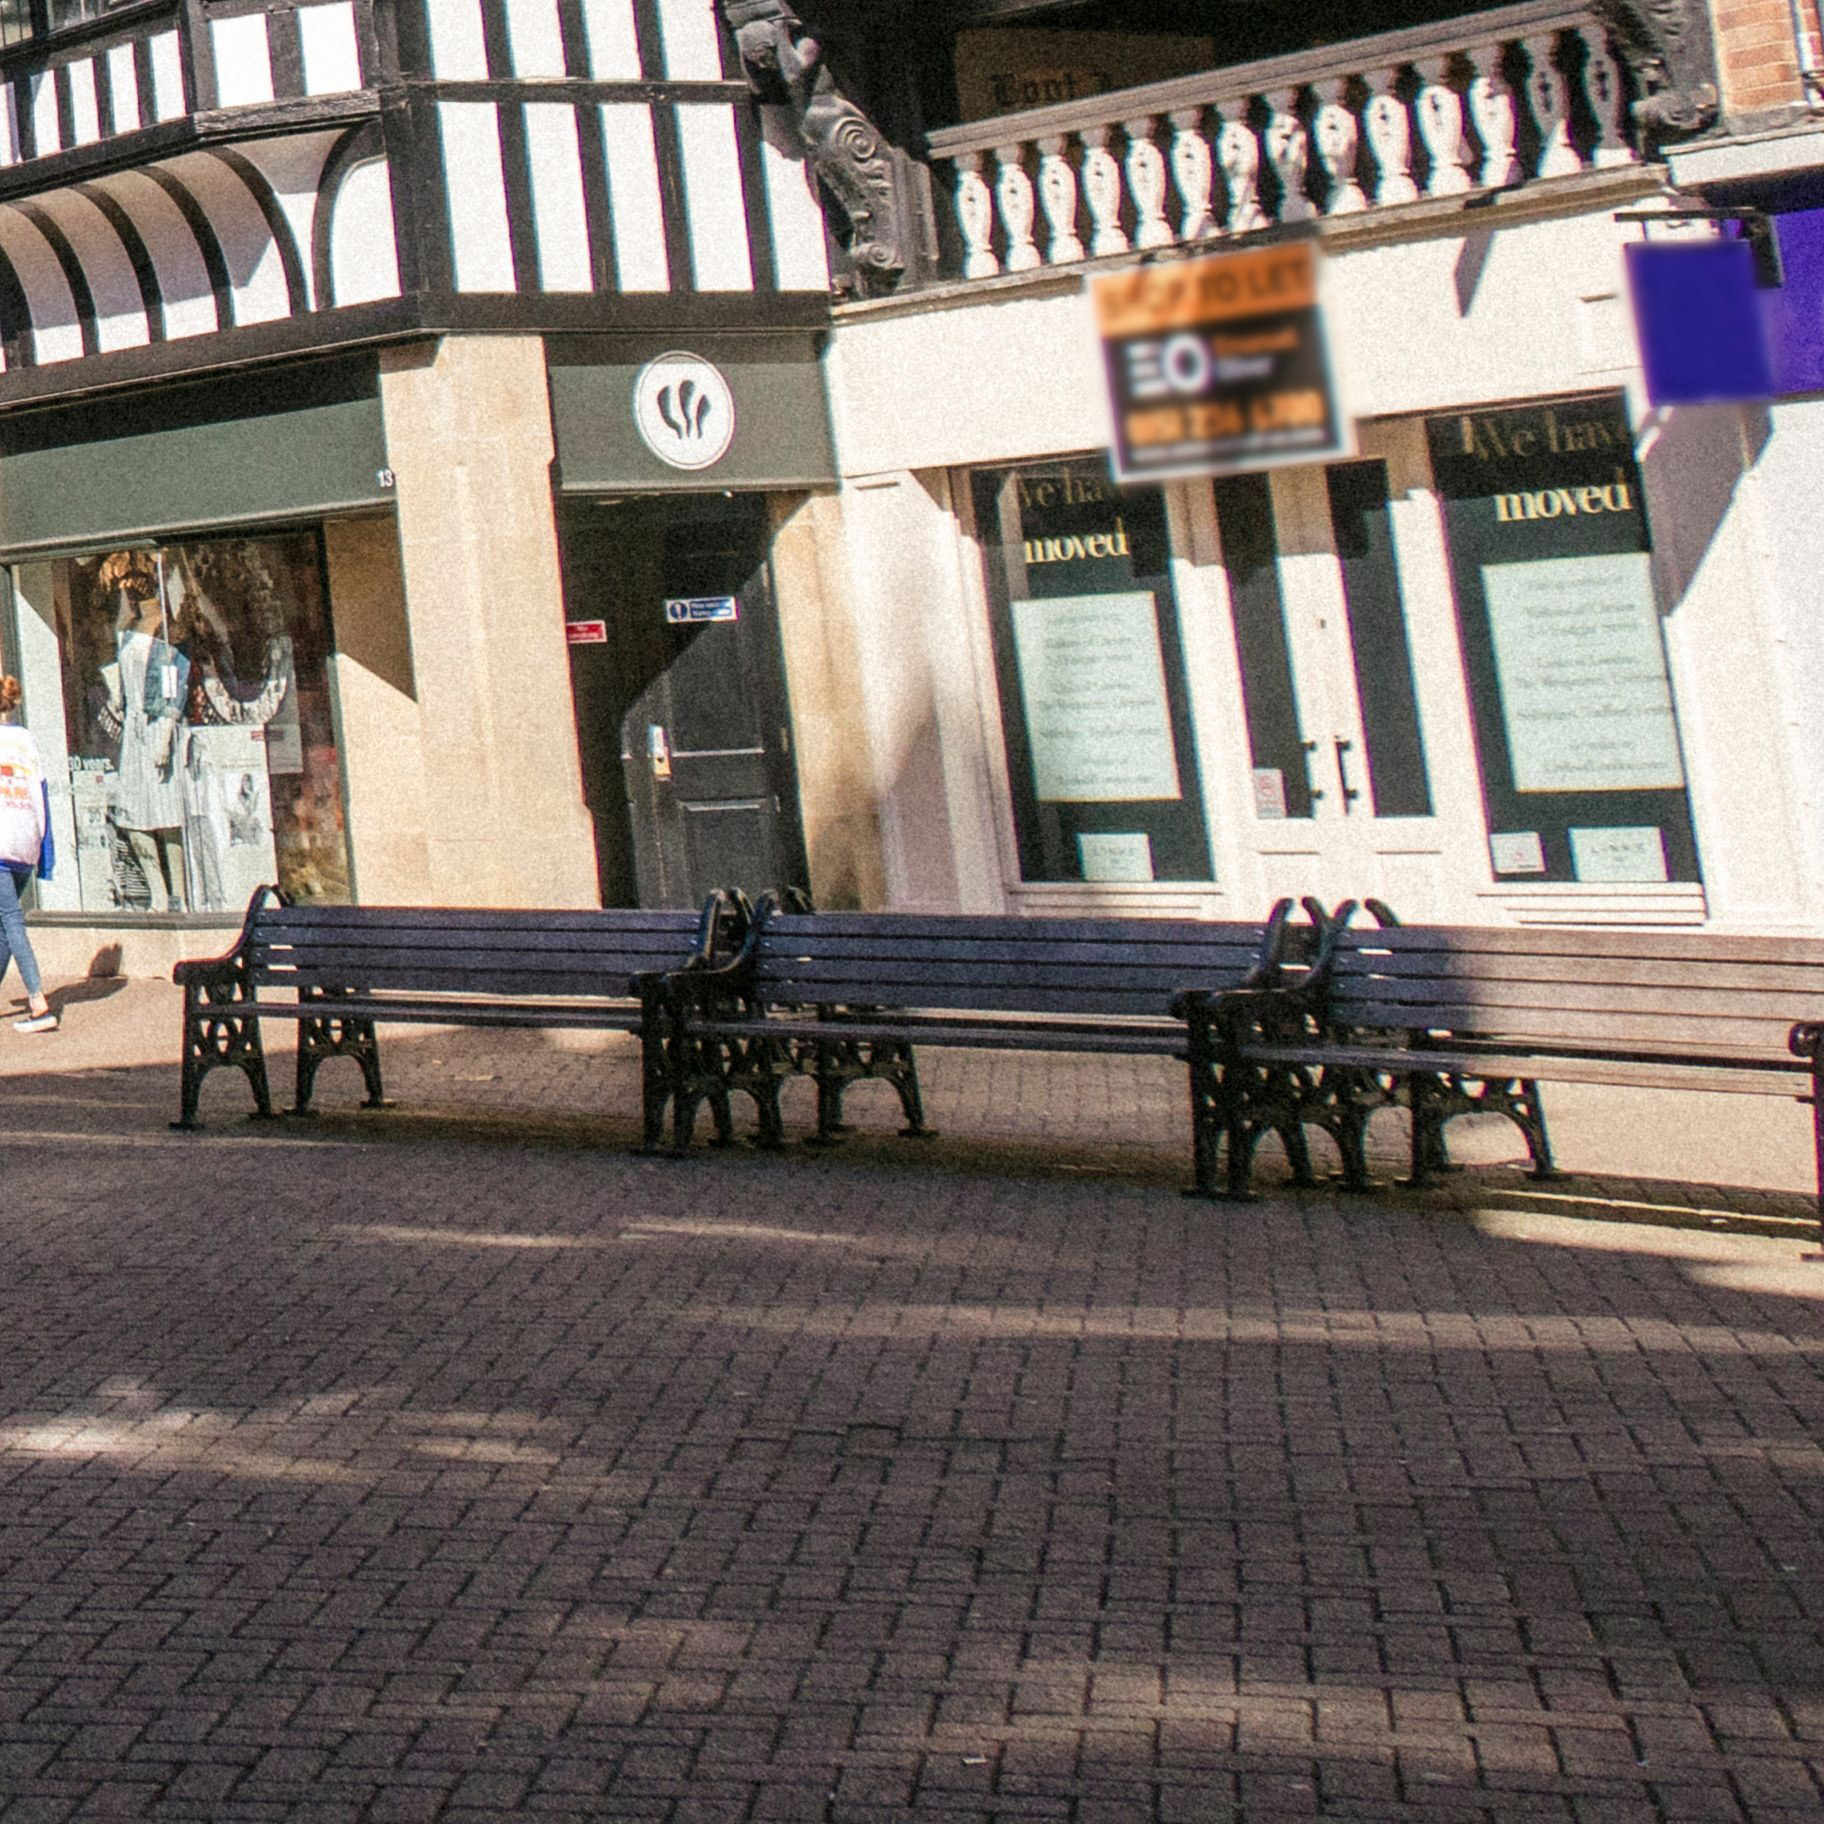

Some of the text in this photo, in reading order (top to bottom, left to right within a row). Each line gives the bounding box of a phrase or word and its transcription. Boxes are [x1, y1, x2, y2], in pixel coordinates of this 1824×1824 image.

[377, 468, 394, 487] 13
[1493, 466, 1633, 522] moved
[1024, 516, 1130, 565] moved
